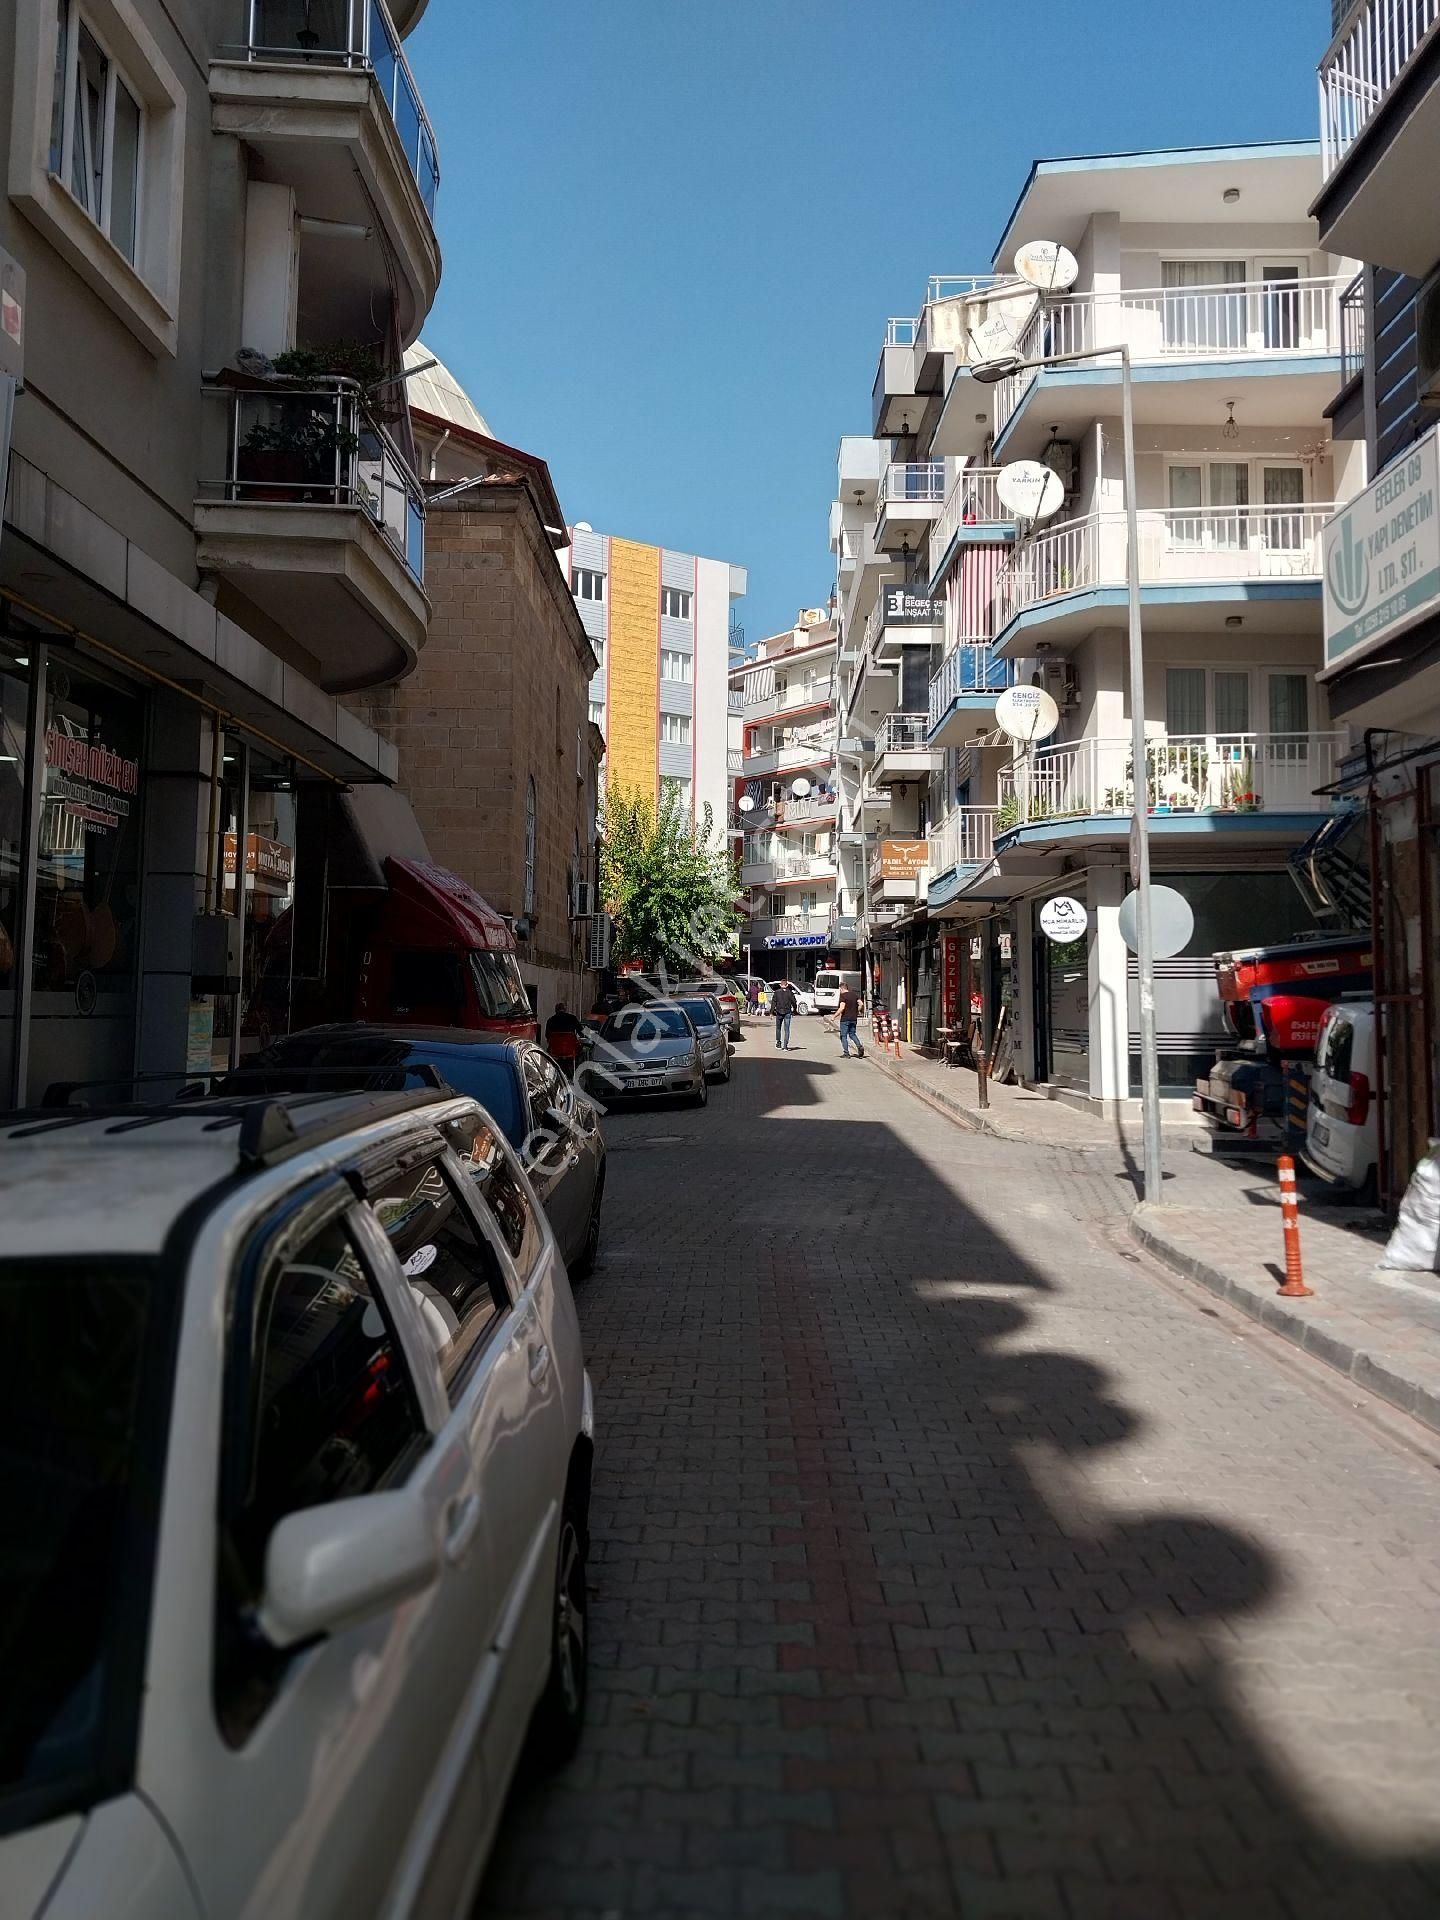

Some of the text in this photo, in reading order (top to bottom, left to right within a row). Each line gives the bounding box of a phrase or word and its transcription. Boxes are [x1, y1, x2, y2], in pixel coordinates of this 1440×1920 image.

[1375, 476, 1405, 514] EFELER
[1367, 489, 1433, 560] YAPI DENETİM
